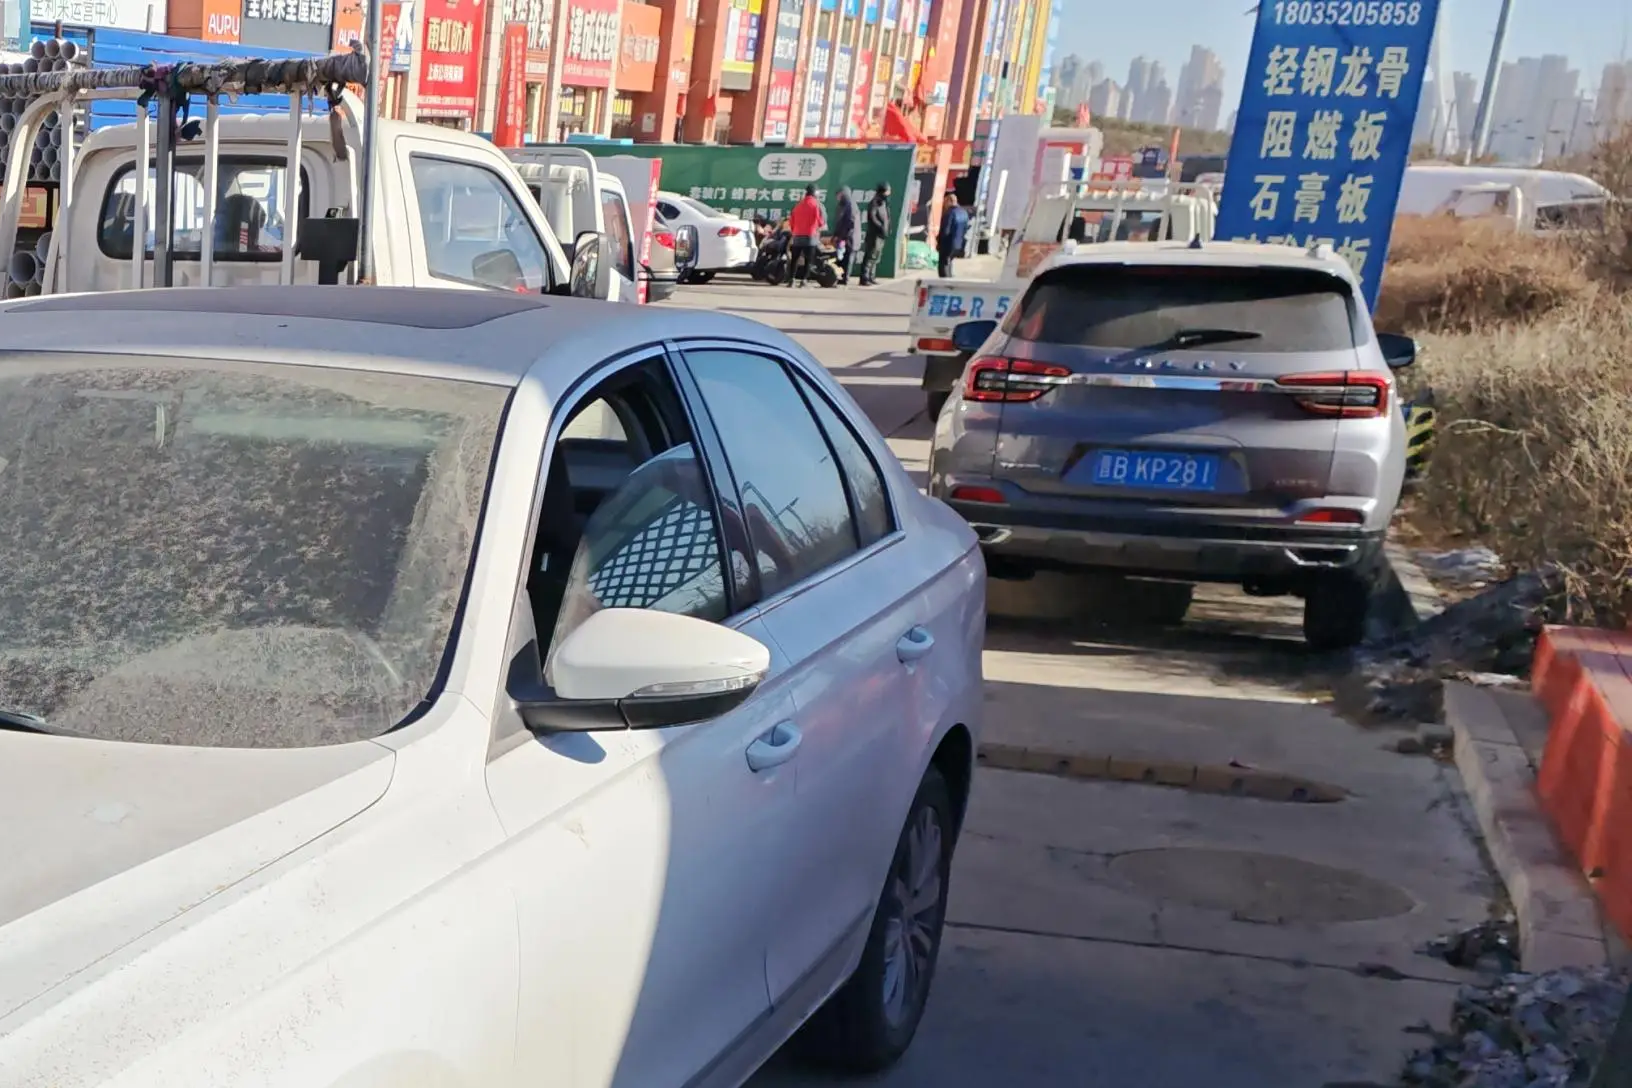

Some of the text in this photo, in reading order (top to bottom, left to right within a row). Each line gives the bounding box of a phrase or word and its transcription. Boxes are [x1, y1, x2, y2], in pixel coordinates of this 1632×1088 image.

[208, 13, 240, 36] AUPU
[1273, 0, 1421, 26] 18035205858
[1263, 45, 1410, 98] 轻钢龙骨
[1259, 109, 1388, 161] 阻燃板
[769, 158, 816, 177] 主营
[1249, 173, 1374, 224] 石膏板
